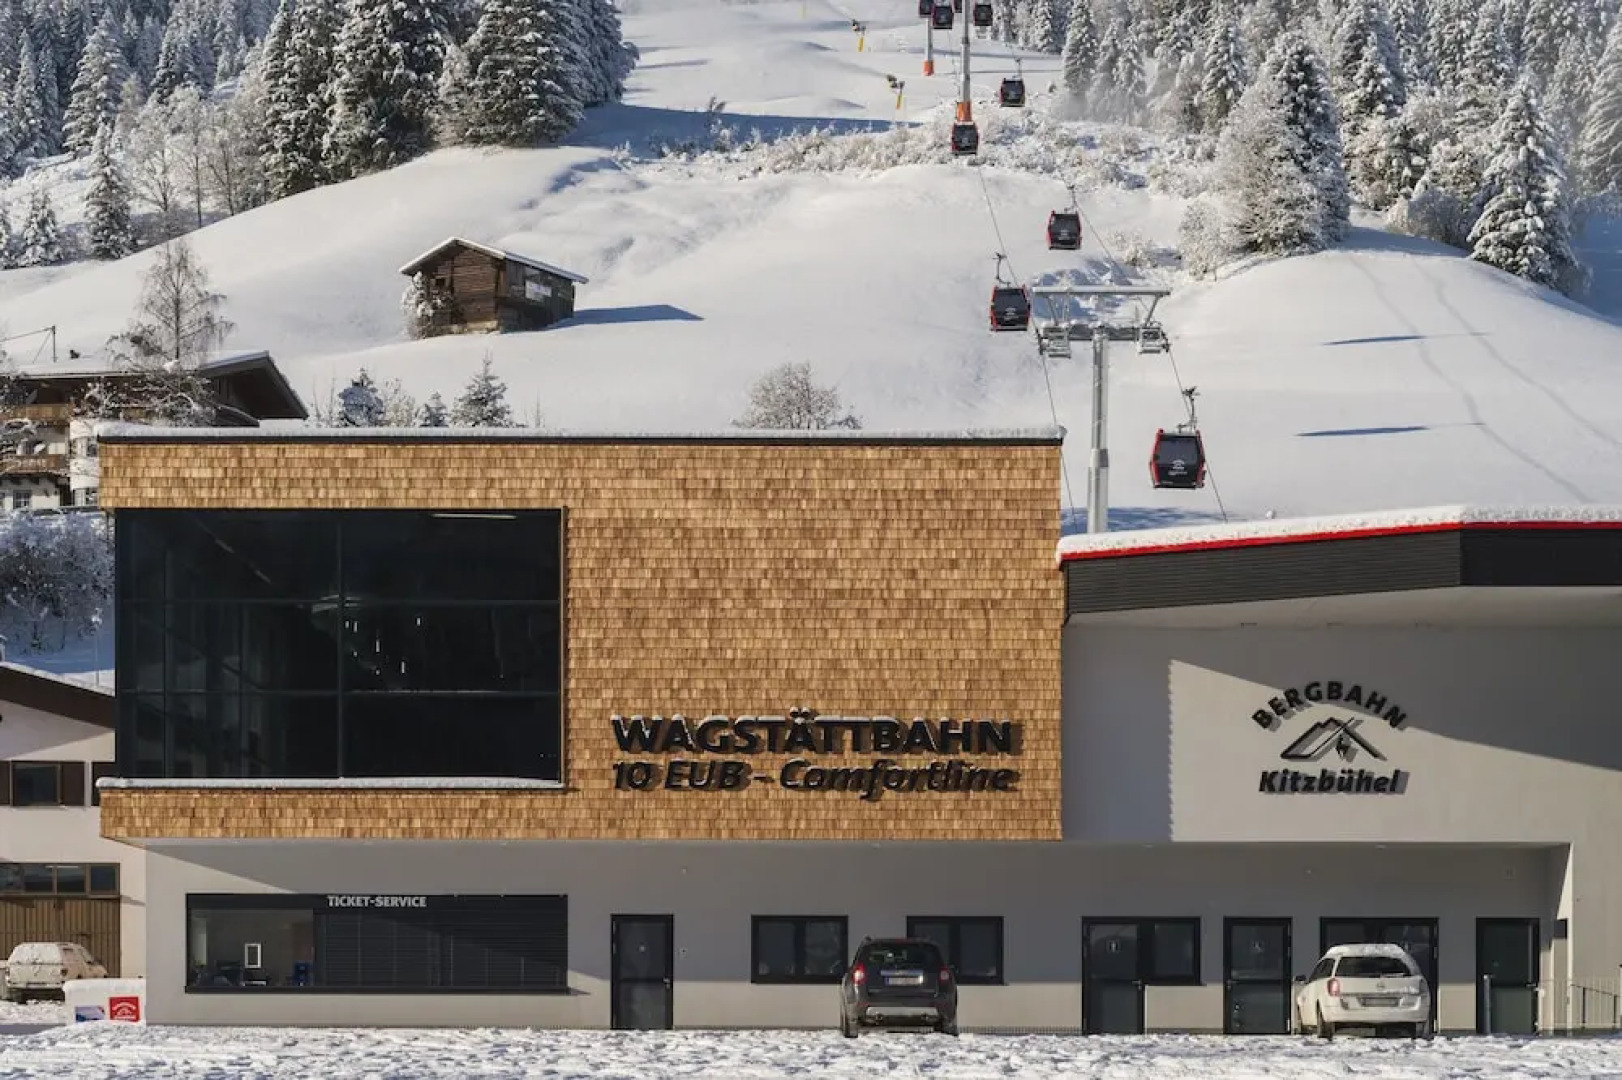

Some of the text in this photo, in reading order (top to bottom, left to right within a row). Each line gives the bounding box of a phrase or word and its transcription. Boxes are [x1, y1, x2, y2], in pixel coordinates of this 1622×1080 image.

[1252, 680, 1407, 729] BERGBAHN
[610, 706, 1013, 753] WAGSTÄTTBAHN
[613, 760, 653, 790] 10
[664, 759, 746, 790] EUB
[780, 759, 1016, 801] Comfortline
[1259, 768, 1402, 793] Kitzbühel
[327, 896, 427, 907] TICKET-SERVICE
